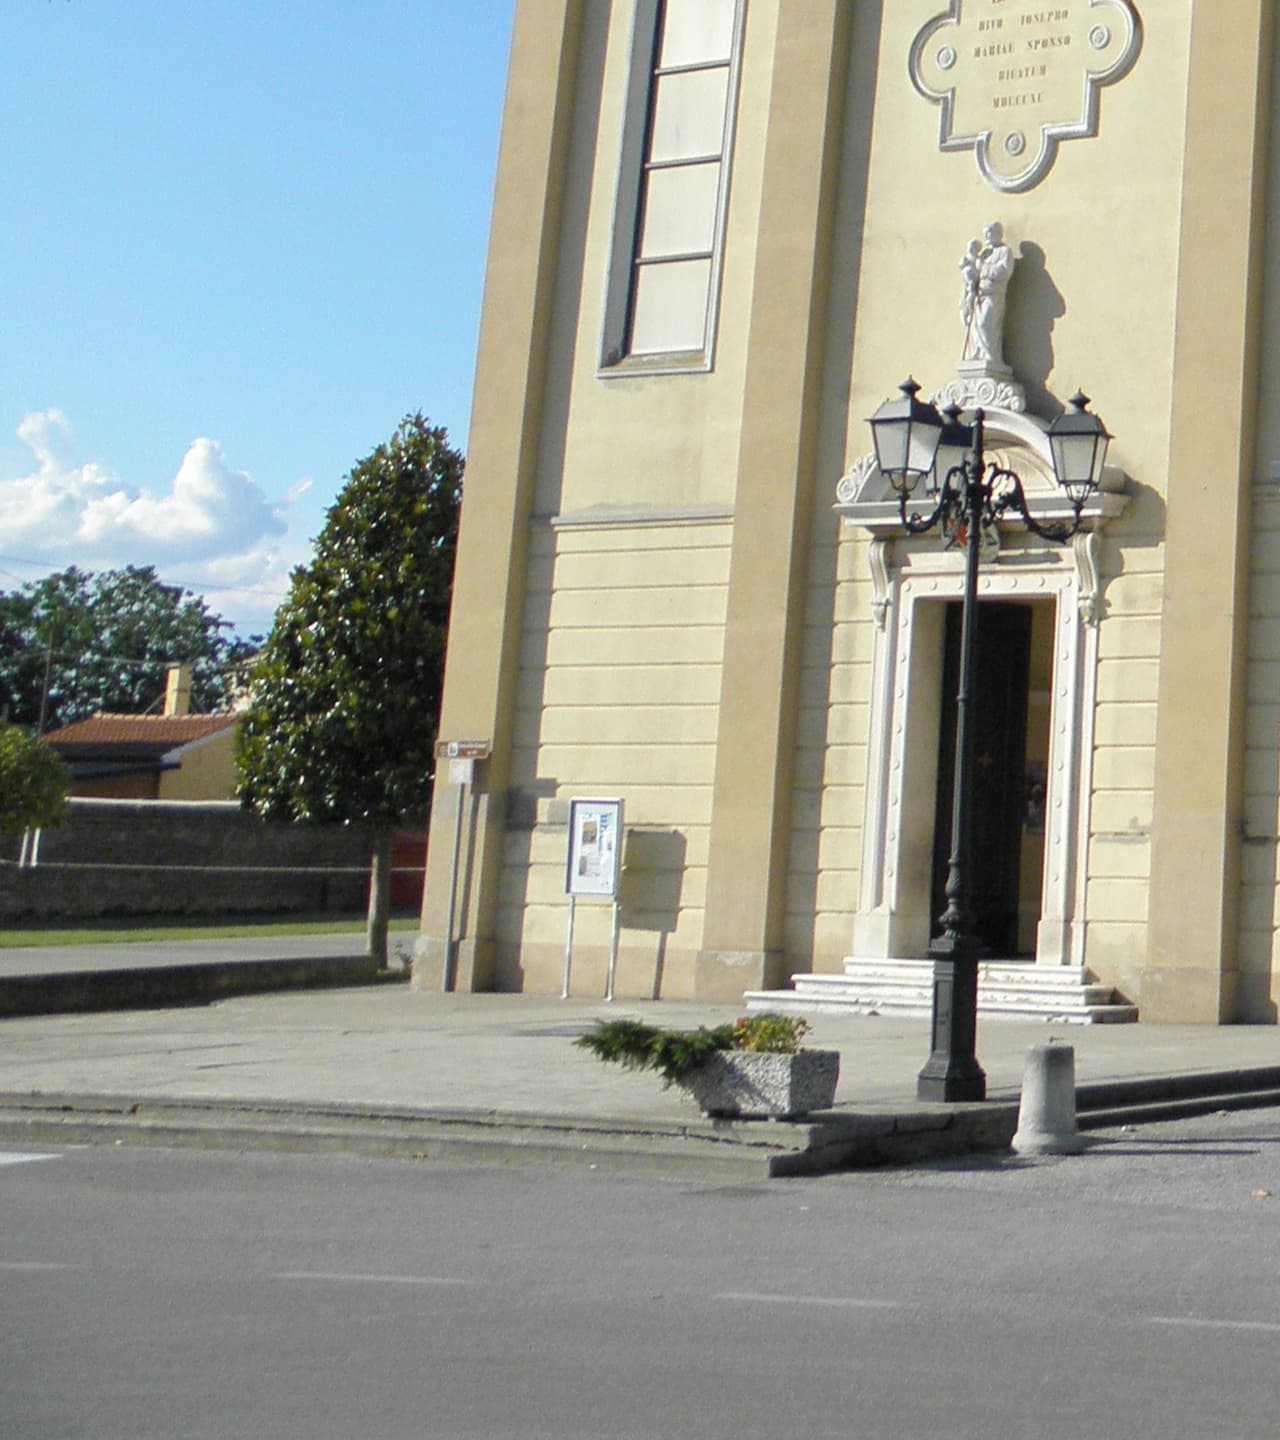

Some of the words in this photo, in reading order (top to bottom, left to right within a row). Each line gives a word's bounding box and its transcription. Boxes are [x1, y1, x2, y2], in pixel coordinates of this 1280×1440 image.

[979, 19, 1003, 31] DIVO
[1021, 10, 1069, 25] IOSEPHO
[974, 44, 1014, 58] MARIAE
[1028, 36, 1070, 50] SPONSO
[999, 65, 1046, 80] DICATUM
